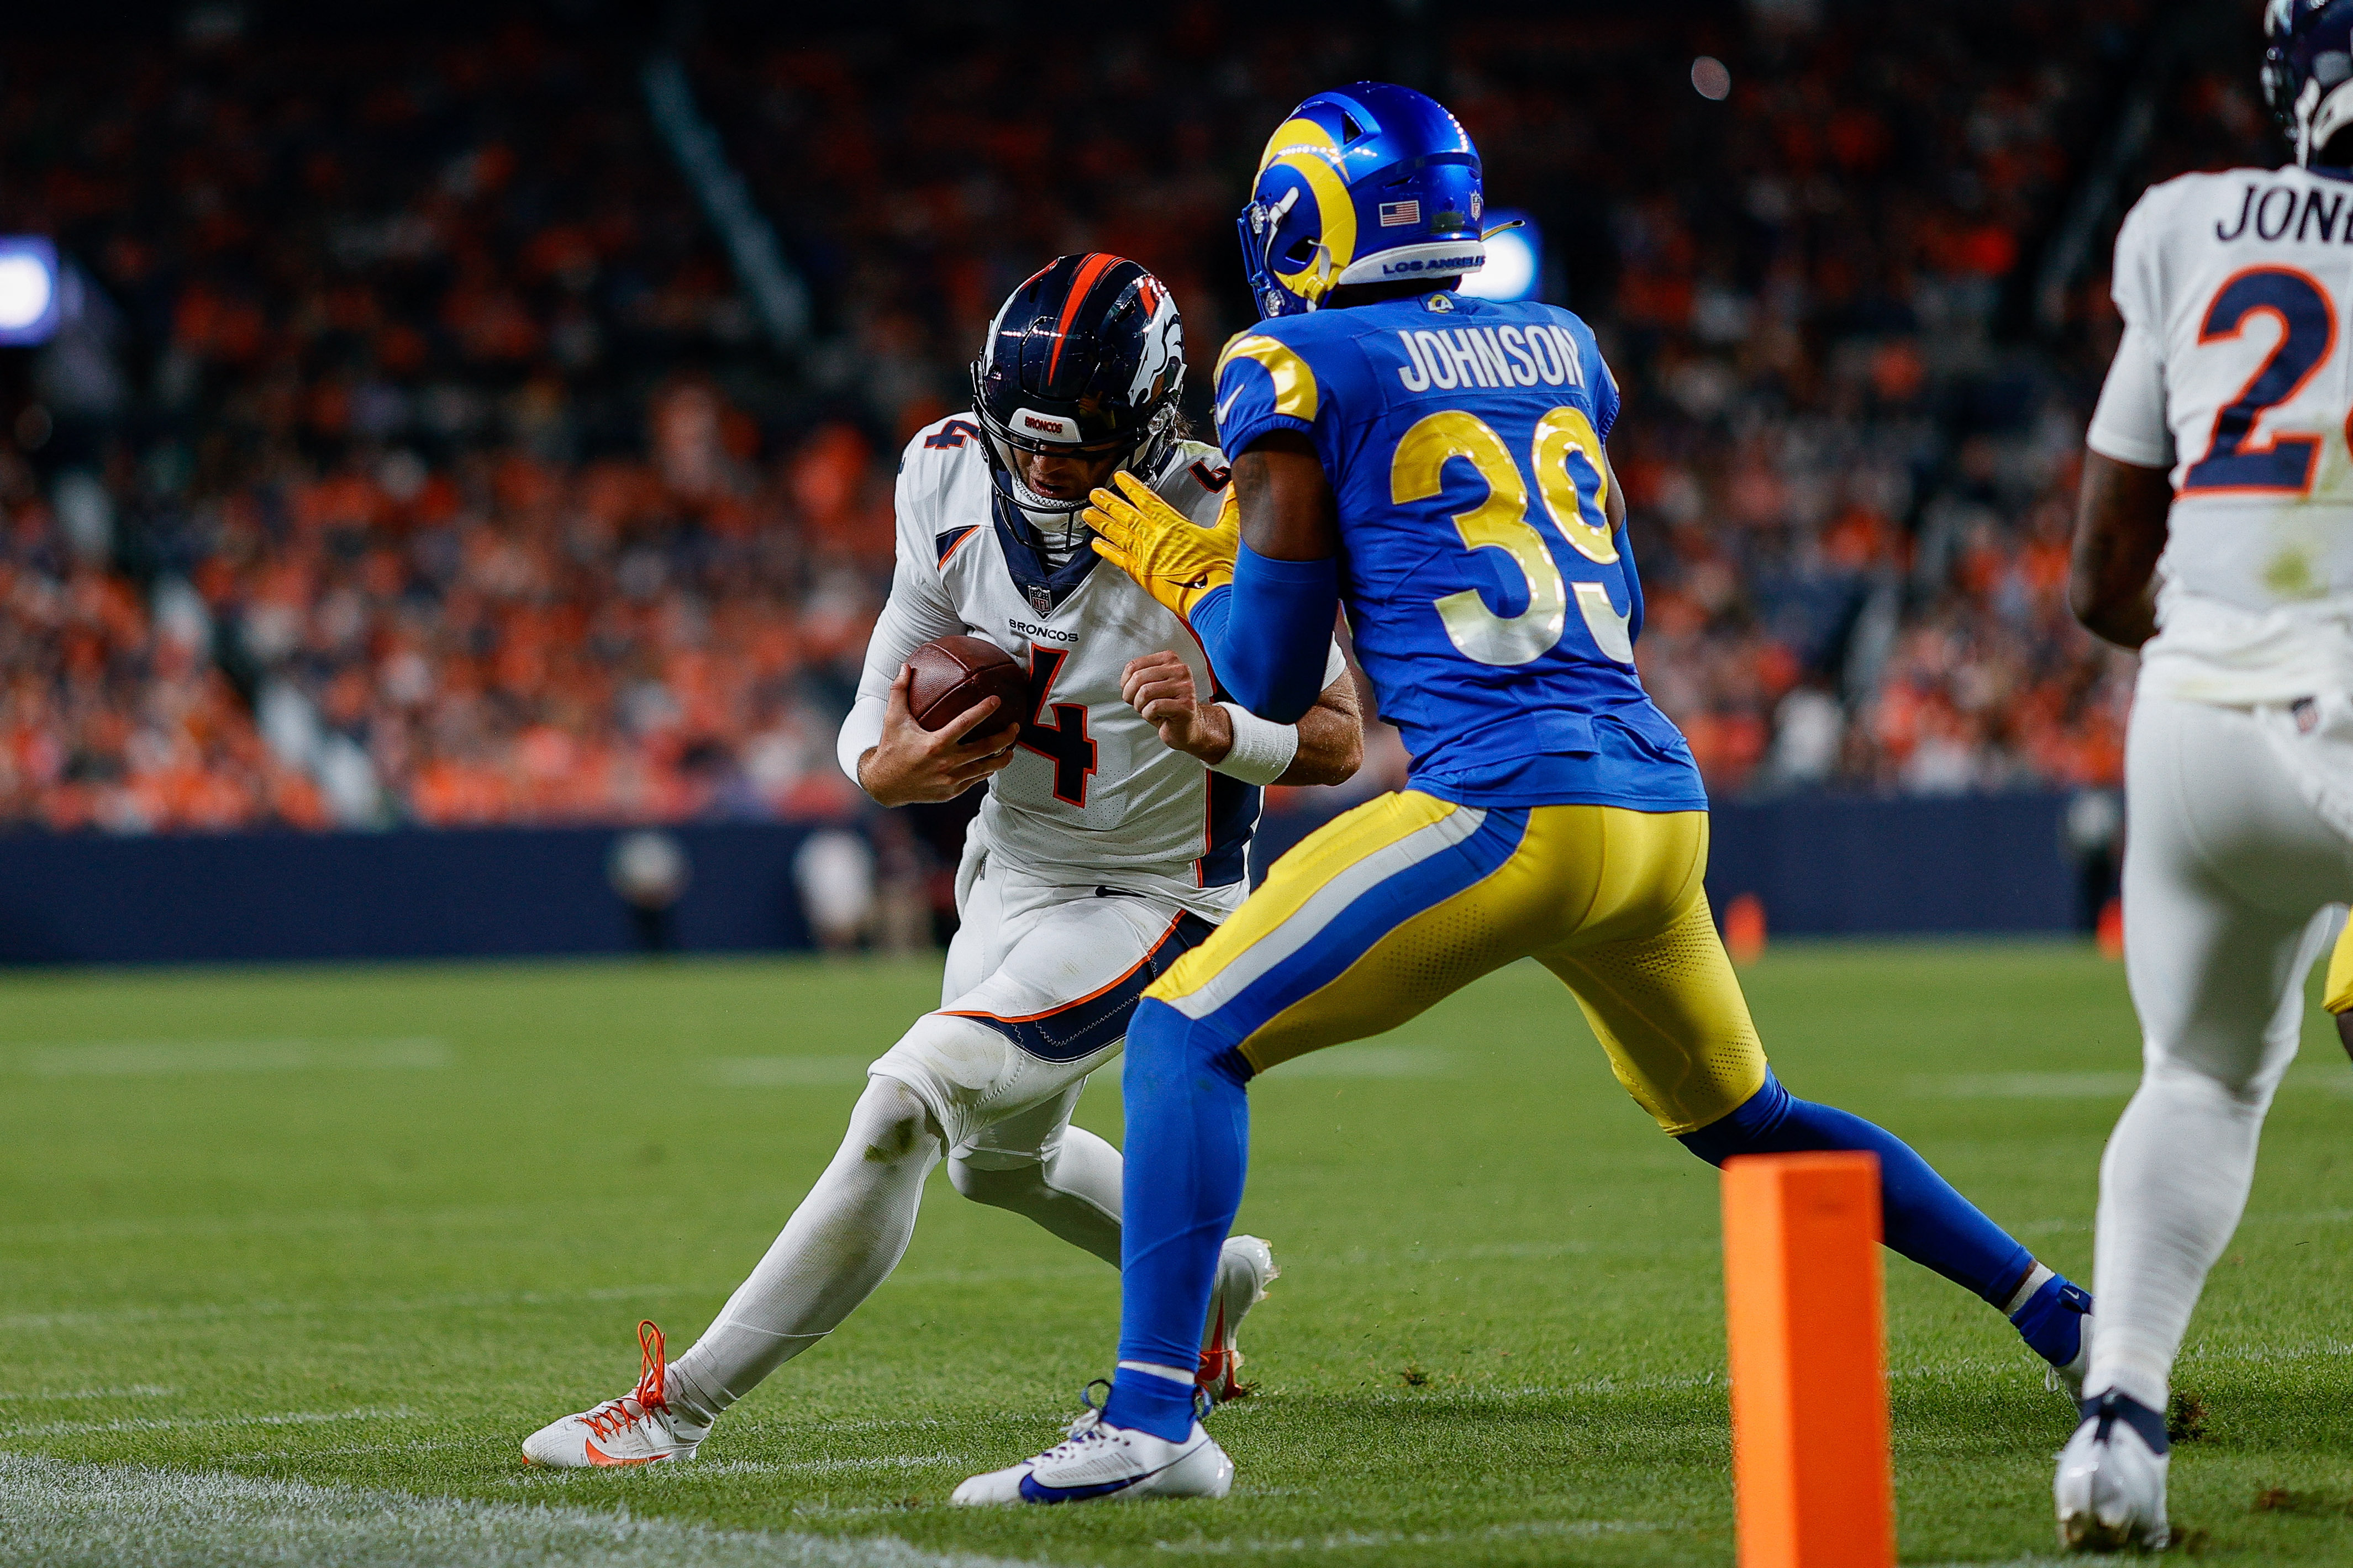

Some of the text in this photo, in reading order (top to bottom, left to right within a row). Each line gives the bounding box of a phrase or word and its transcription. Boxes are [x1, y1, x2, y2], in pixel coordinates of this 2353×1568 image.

[1382, 260, 1424, 274] LOS
[1397, 325, 1586, 393] JOHNSON
[2174, 261, 2353, 500] 2
[924, 419, 981, 450] 4
[1024, 415, 1063, 434] BRONCOS
[1390, 405, 1635, 666] 39
[1032, 596, 1050, 611] NFL
[1008, 618, 1079, 642] BRONCOS
[1017, 641, 1098, 809] 4
